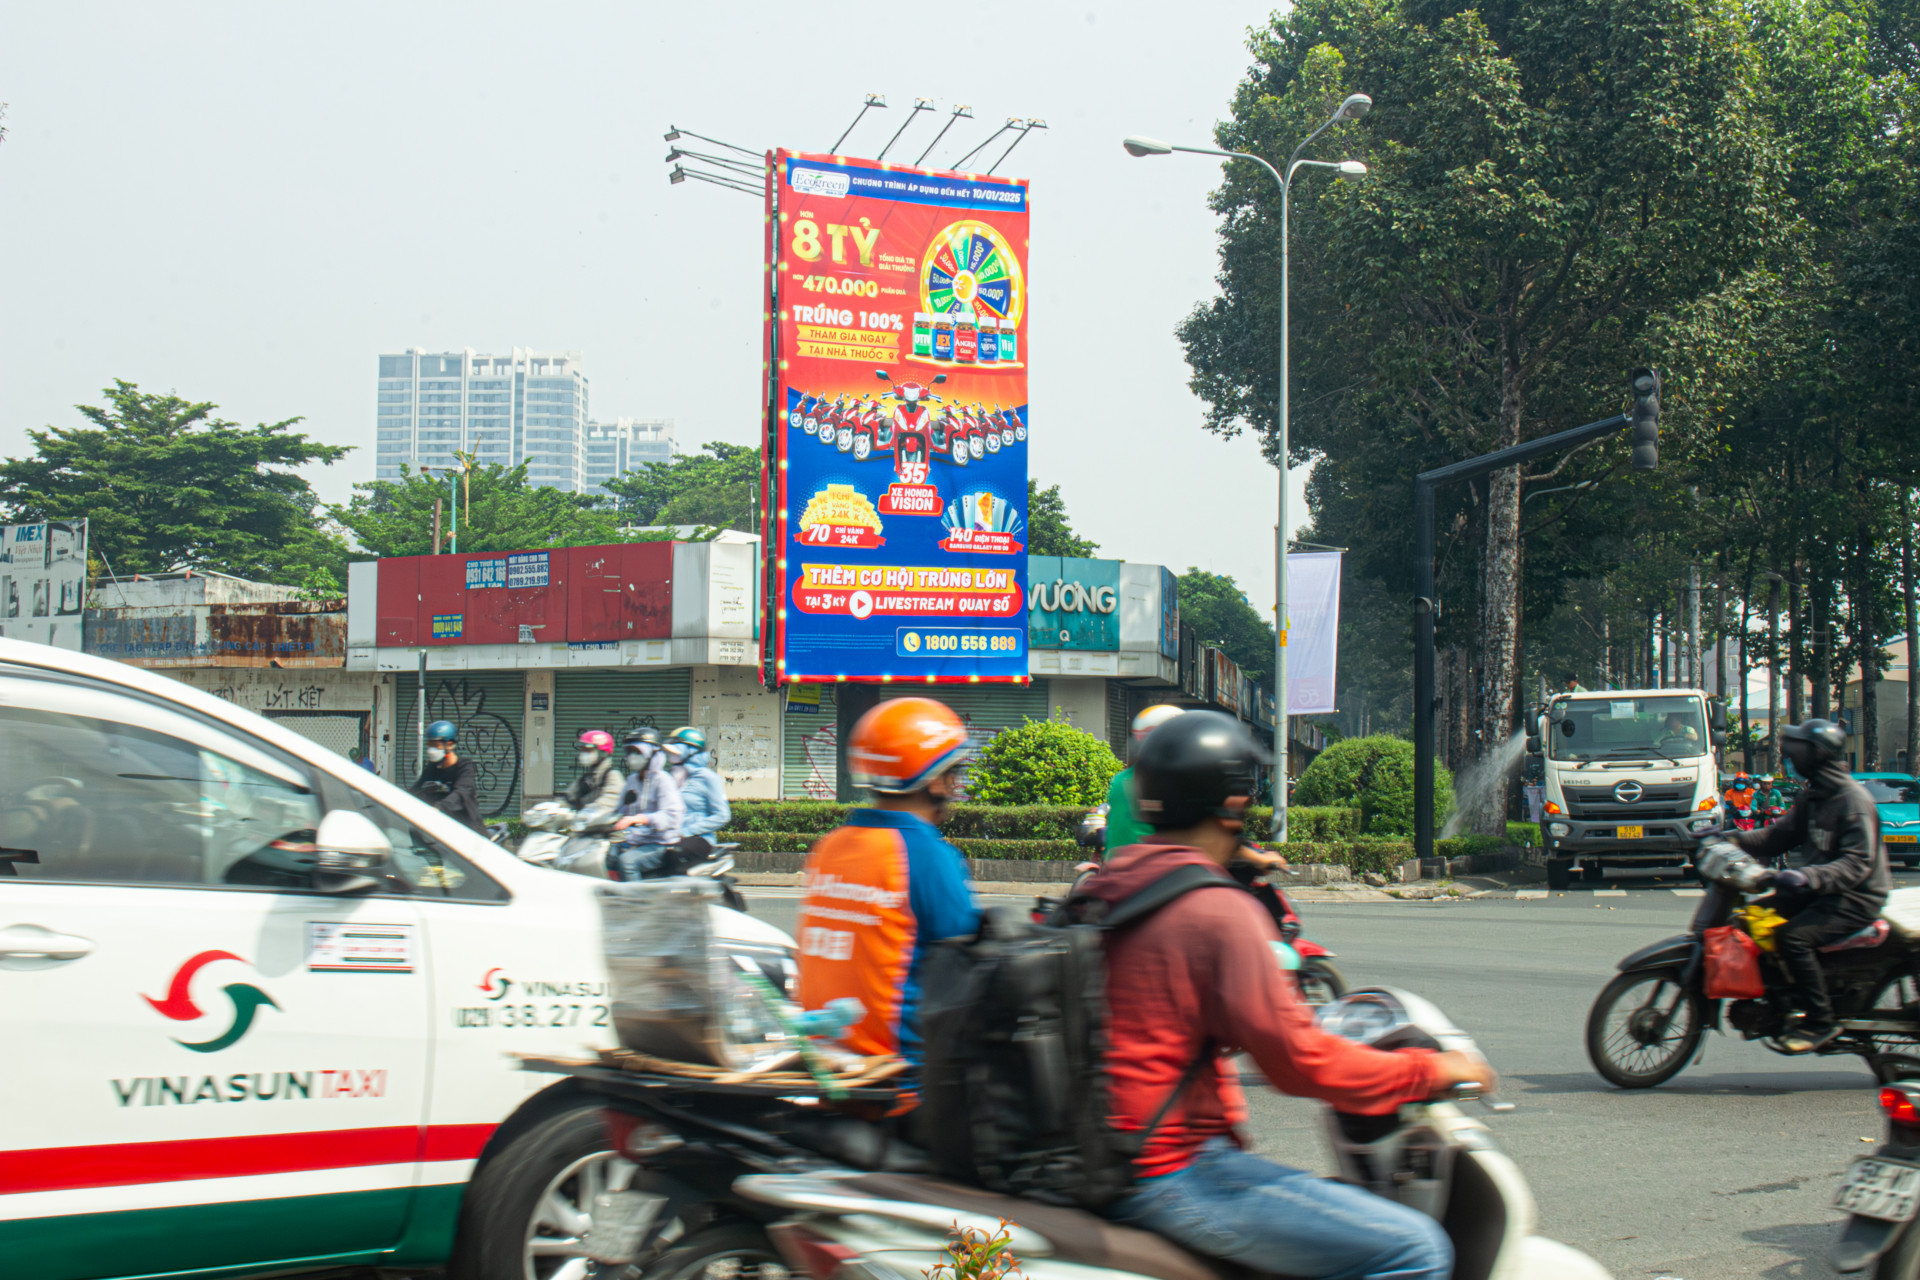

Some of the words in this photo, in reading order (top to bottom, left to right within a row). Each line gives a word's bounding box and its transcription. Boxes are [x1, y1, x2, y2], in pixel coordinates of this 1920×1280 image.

[795, 173, 845, 191] Ecogreen
[972, 188, 1021, 203] 10/01/2025
[792, 219, 822, 261] 8
[826, 217, 880, 267] TỶ
[802, 274, 879, 298] 470.000
[793, 302, 853, 326] TRÚNG
[859, 310, 904, 331] 100%
[810, 329, 837, 340] THAM
[839, 332, 857, 341] GIA
[860, 334, 887, 344] NGAY
[936, 334, 951, 346] JEX
[809, 345, 824, 357] TẠI
[827, 346, 847, 357] NHÀ
[851, 347, 883, 360] THUỐC
[900, 462, 927, 484] 35
[891, 487, 903, 497] XE
[904, 488, 934, 498] HONDA
[891, 497, 934, 511] VISION
[831, 509, 850, 519] 24K
[16, 525, 45, 542] IMEX
[808, 523, 831, 543] 70
[840, 534, 859, 545] 24K
[949, 527, 973, 543] 140
[809, 565, 856, 586] THÊM
[859, 568, 883, 586] CƠ
[886, 567, 914, 590] HỘI
[918, 568, 972, 588] TRÚNG
[975, 569, 1007, 588] LỚN
[805, 596, 821, 608] TẠI
[821, 593, 832, 609] 3
[832, 595, 846, 607] KỲ
[875, 596, 955, 610] LIVESTREAM
[959, 598, 991, 612] QUAY
[992, 595, 1011, 611] SỐ
[1028, 578, 1117, 614] VƯƠNG
[925, 635, 958, 650] 1800
[961, 635, 988, 651] 556
[990, 636, 1016, 651] 889
